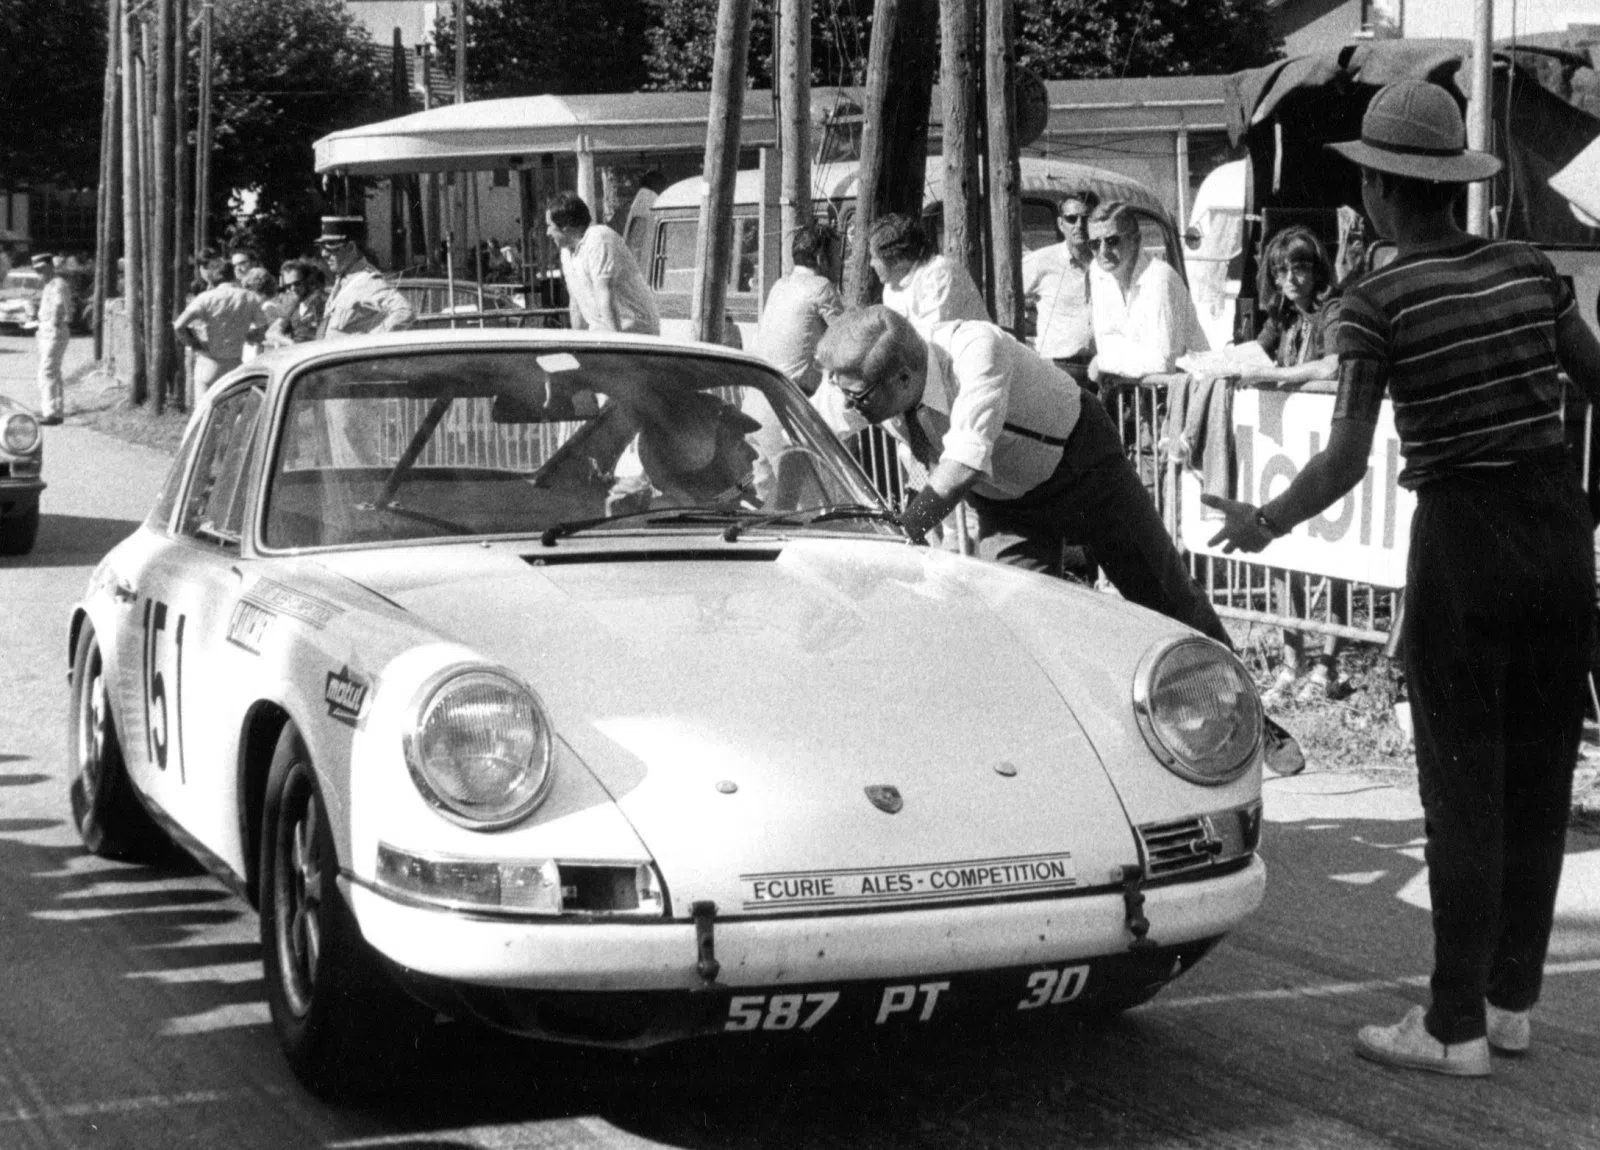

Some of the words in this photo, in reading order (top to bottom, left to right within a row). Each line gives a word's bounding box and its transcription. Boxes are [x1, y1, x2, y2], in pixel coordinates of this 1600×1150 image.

[143, 598, 186, 785] 151
[753, 878, 835, 900] ECURIE
[724, 991, 840, 1032] 587
[874, 981, 950, 1025] PT
[1017, 964, 1090, 1010] 30
